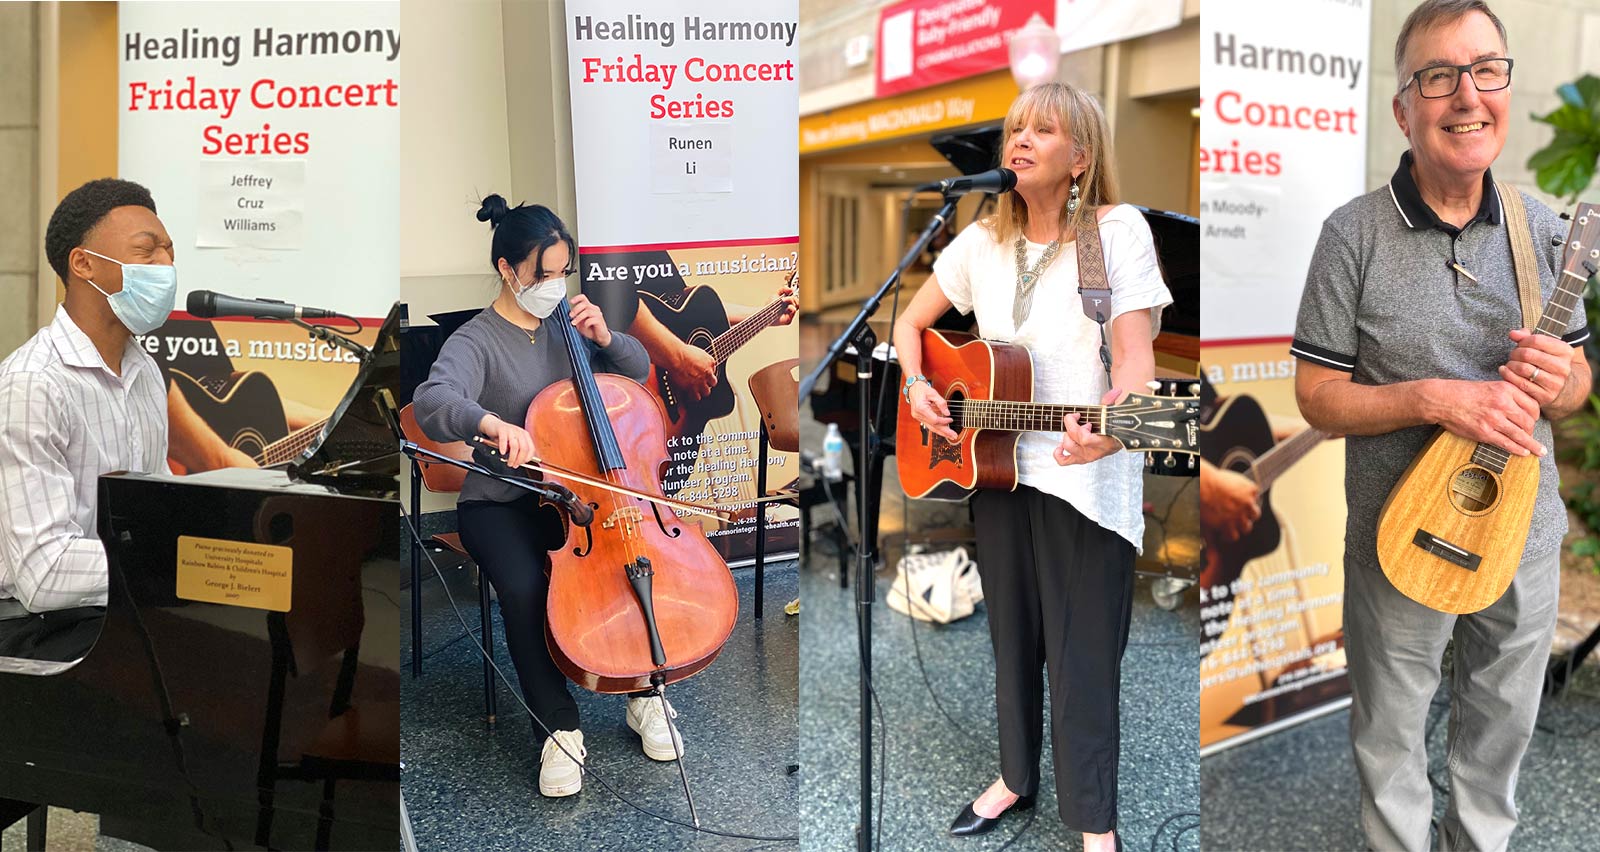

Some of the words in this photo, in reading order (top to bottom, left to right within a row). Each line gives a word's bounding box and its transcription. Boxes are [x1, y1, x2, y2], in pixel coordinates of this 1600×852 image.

[575, 14, 675, 47] Healing
[684, 16, 798, 47] Harmony
[125, 28, 241, 67] Healing
[253, 27, 400, 61] Harmony
[1214, 31, 1362, 90] Harmony
[582, 54, 677, 89] Friday
[684, 57, 794, 82] Concert
[128, 76, 241, 119] Friday
[250, 79, 398, 109] Concert
[650, 93, 734, 119] Series
[1214, 91, 1358, 135] Concert
[202, 123, 309, 155] Series
[669, 137, 712, 150] Runen
[685, 162, 696, 174] Li
[1200, 140, 1282, 176] eries
[231, 175, 273, 189] Jeffrey
[237, 198, 264, 209] Cruz
[224, 219, 276, 232] Williams
[1205, 225, 1247, 240] Arndt
[586, 263, 628, 281] Are
[632, 263, 673, 285] you
[679, 263, 691, 276] a
[696, 251, 799, 276] musician?
[135, 335, 160, 354] re
[165, 336, 218, 361] you
[225, 339, 242, 357] a
[1207, 363, 1225, 384] a
[682, 434, 693, 446] to
[695, 431, 714, 444] the
[716, 430, 760, 443] commun
[674, 449, 698, 461] note
[701, 448, 712, 459] at
[715, 448, 722, 456] a
[724, 444, 751, 456] time.
[676, 463, 694, 475] the
[697, 459, 736, 472] Healing
[740, 454, 786, 467] Harony
[704, 471, 752, 488] program.
[205, 579, 229, 590] George
[1211, 585, 1229, 600] to
[1230, 578, 1254, 595] the
[1200, 601, 1233, 620] note
[1205, 619, 1230, 637] the
